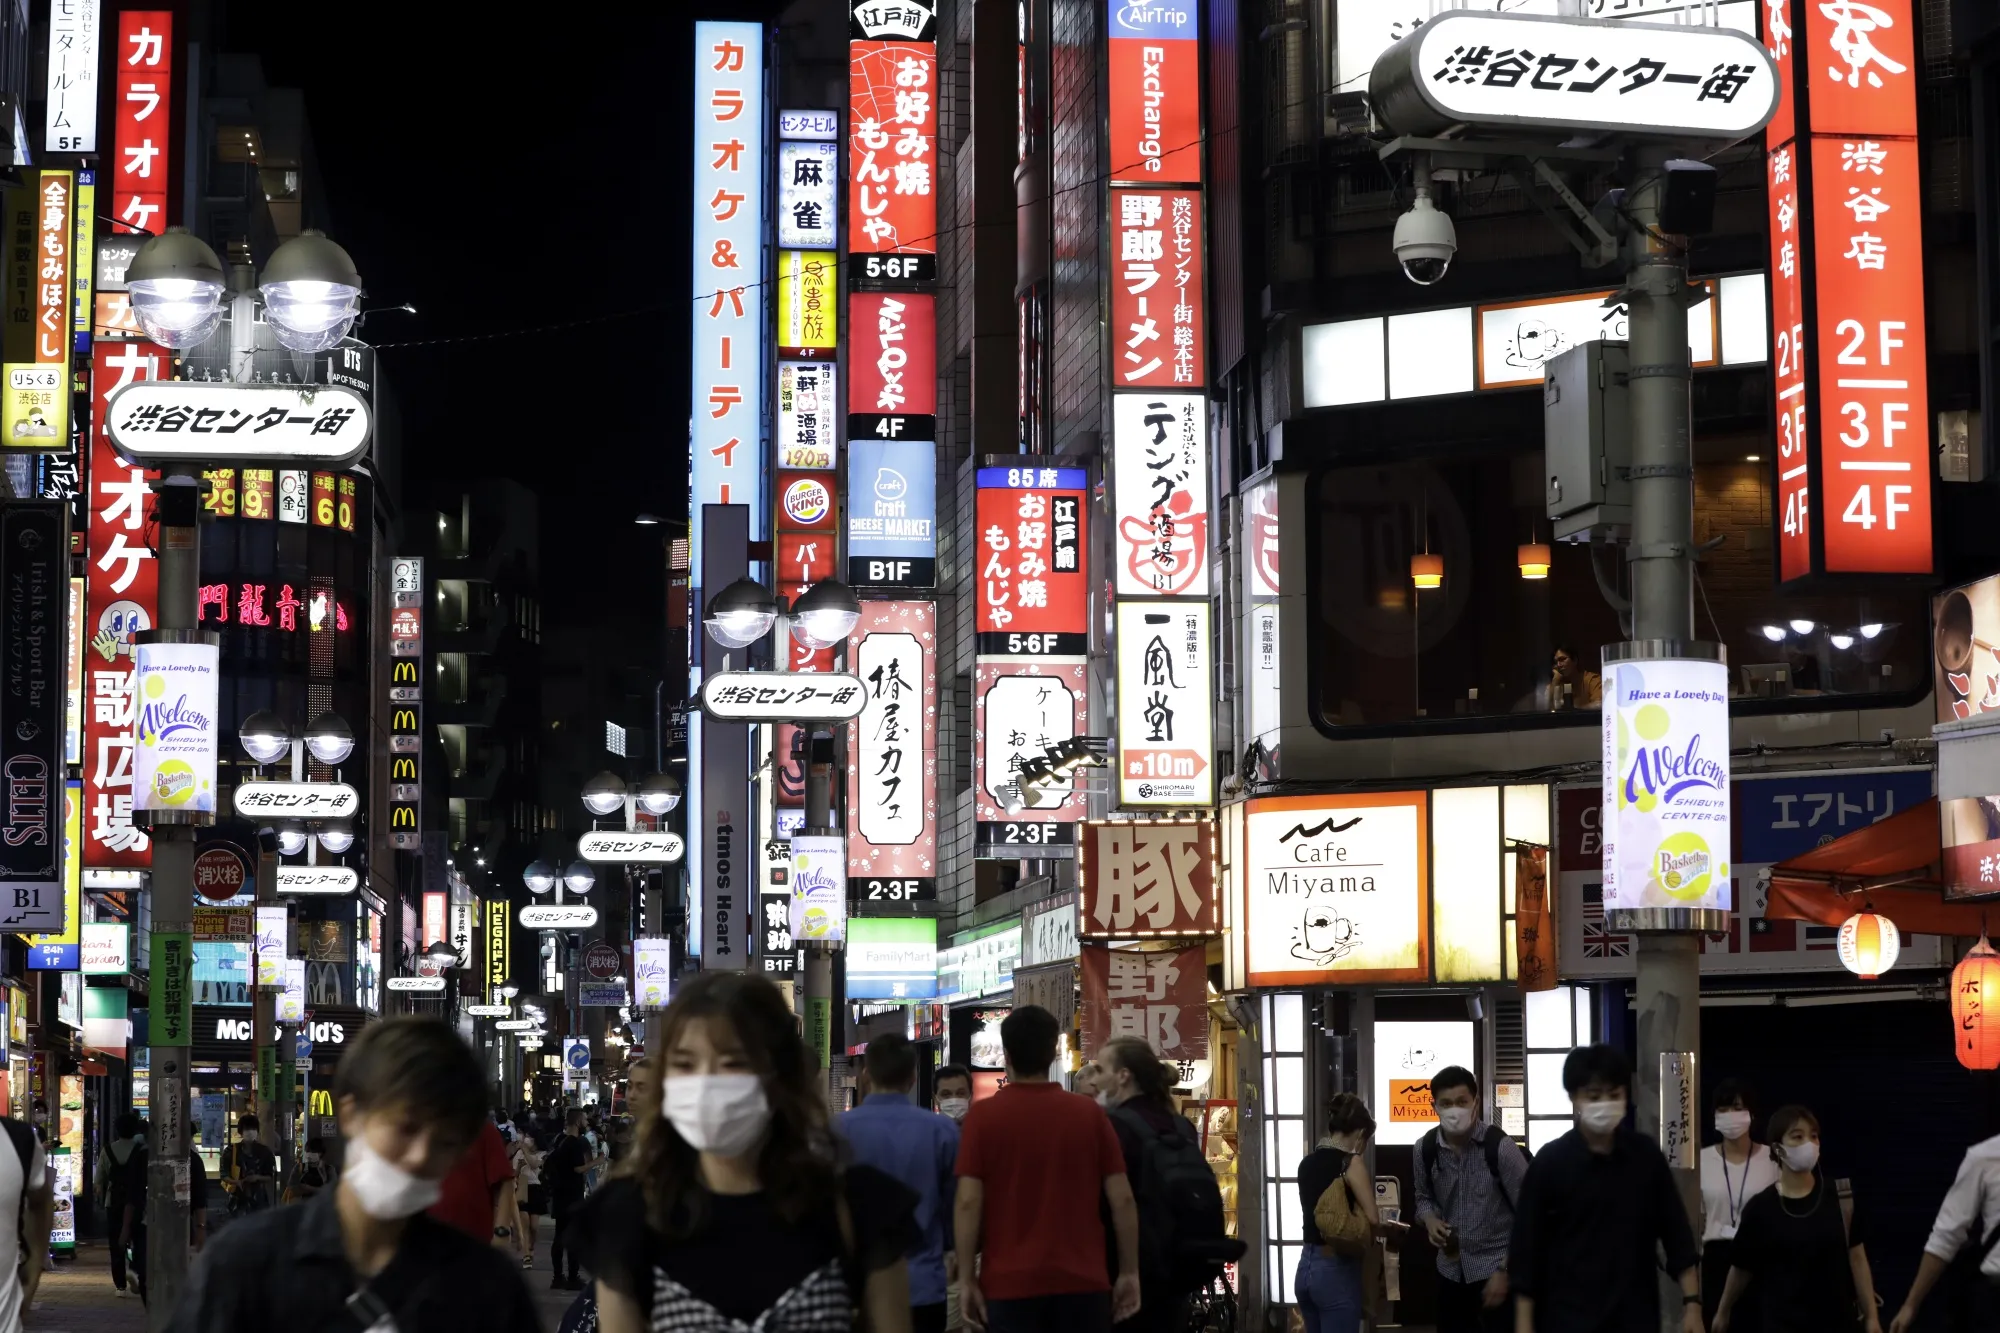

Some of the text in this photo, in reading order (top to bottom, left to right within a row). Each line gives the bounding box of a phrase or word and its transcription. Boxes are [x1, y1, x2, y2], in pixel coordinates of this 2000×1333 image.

[863, 7, 922, 29] 江戸前
[1129, 8, 1187, 28] AirTrip
[1432, 45, 1757, 104] 渋谷センター街
[1139, 46, 1165, 173] Exchange
[122, 27, 164, 234] カラオケ
[780, 116, 836, 133] センタービル
[895, 56, 930, 196] お好み焼
[58, 137, 82, 149] 5F
[819, 144, 836, 156] 5F
[857, 117, 890, 244] もんじゃ
[792, 158, 824, 230] 麻雀
[1841, 140, 1891, 270] 渋谷店
[1774, 149, 1795, 279] 渋谷店
[41, 181, 67, 357] 全身もみほぐし
[1121, 194, 1164, 382] 野郎ラーメン
[799, 349, 816, 357] 4F
[1777, 323, 1802, 378] 2F
[1835, 319, 1906, 366] 2F
[344, 348, 361, 372] BTS
[14, 373, 56, 386] りらくる
[18, 392, 52, 406] 渋谷店
[120, 405, 356, 436] 渋谷センター街
[875, 417, 905, 438] 4F
[1781, 405, 1805, 458] 3F
[1839, 401, 1909, 448] 3F
[786, 449, 830, 467] 190円
[282, 495, 296, 512] 金
[790, 488, 822, 503] BURGER
[791, 495, 824, 514] KING
[1842, 484, 1912, 530] 4F
[874, 500, 906, 518] Craft
[1783, 487, 1808, 537] 4F
[850, 518, 932, 537] CHEESE MARKET
[1054, 500, 1076, 570] 江戸前
[1016, 493, 1047, 608] お好み焼
[869, 561, 911, 581] B1F
[983, 524, 1013, 629] もんじゃ
[1152, 574, 1173, 590] B1
[142, 664, 160, 673] Have
[168, 664, 197, 673] Lovely
[197, 665, 211, 674] Day
[1143, 613, 1187, 742] 一風堂
[713, 686, 858, 705] 渋谷センター街
[1629, 689, 1662, 701] Have
[1663, 691, 1671, 699] a
[1673, 690, 1711, 702] Lovely
[139, 693, 211, 741] Welcome
[867, 658, 914, 821] 椿屋カフェ
[1625, 733, 1727, 804] Welcome
[3, 754, 48, 847] CELTS
[240, 793, 352, 808] 渋谷センター街
[1673, 797, 1725, 808] SHIBUYA
[585, 840, 679, 853] 渋谷センター街
[716, 810, 733, 889] atmos
[1294, 842, 1348, 863] Cafe
[197, 864, 240, 886] 消火栓
[1093, 825, 1203, 931] 豚
[1267, 872, 1377, 899] Miyama
[12, 888, 42, 908] B1
[523, 911, 594, 923] 渋谷センター街
[716, 895, 732, 956] Heart
[43, 945, 64, 954] 24h
[45, 957, 60, 966] 1F
[589, 955, 618, 969] 消火栓
[866, 950, 931, 963] FamilyMart
[764, 959, 793, 972] B1F
[164, 939, 180, 1040] 客引きは犯罪です
[1961, 979, 1981, 1050] ホッピー
[1679, 1076, 1691, 1145] バスケットボール
[1666, 1120, 1678, 1163] ストリート
